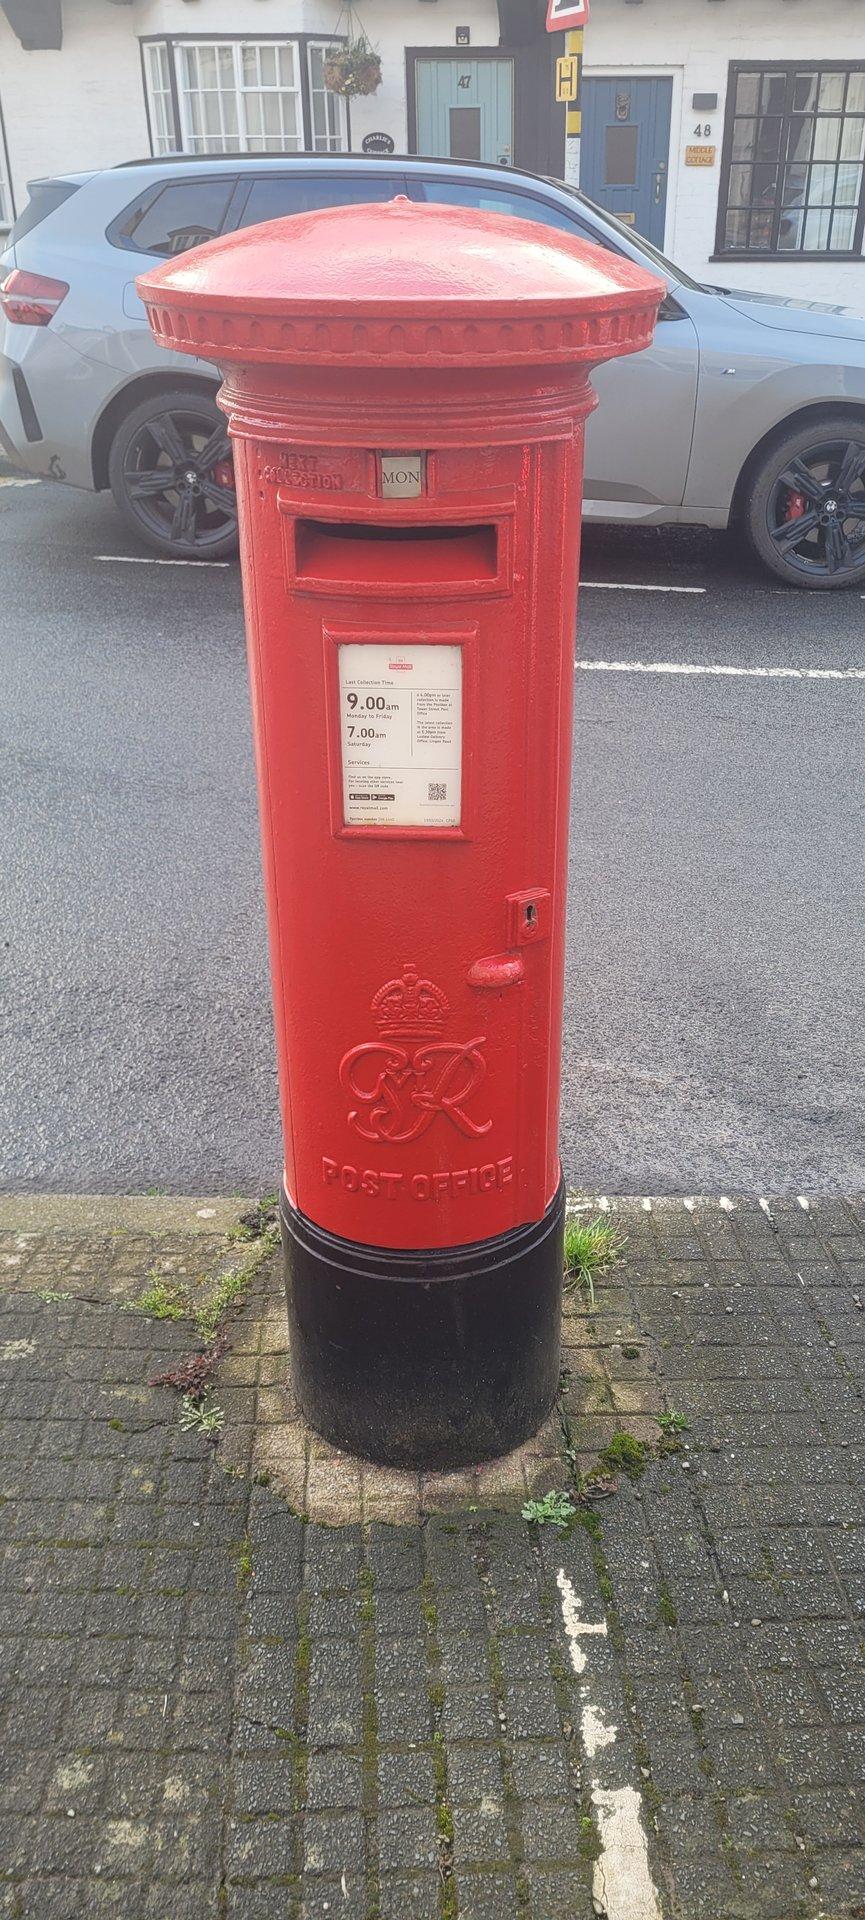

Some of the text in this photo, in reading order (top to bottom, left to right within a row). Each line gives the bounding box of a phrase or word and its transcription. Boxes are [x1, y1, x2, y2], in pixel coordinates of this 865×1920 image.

[457, 75, 471, 88] 47
[693, 124, 711, 136] 48
[264, 465, 342, 490] COLLECTION
[382, 471, 420, 484] MON
[347, 693, 400, 711] 9.00am
[347, 726, 387, 738] 7.00am
[322, 1156, 513, 1201] POST OFFICE
